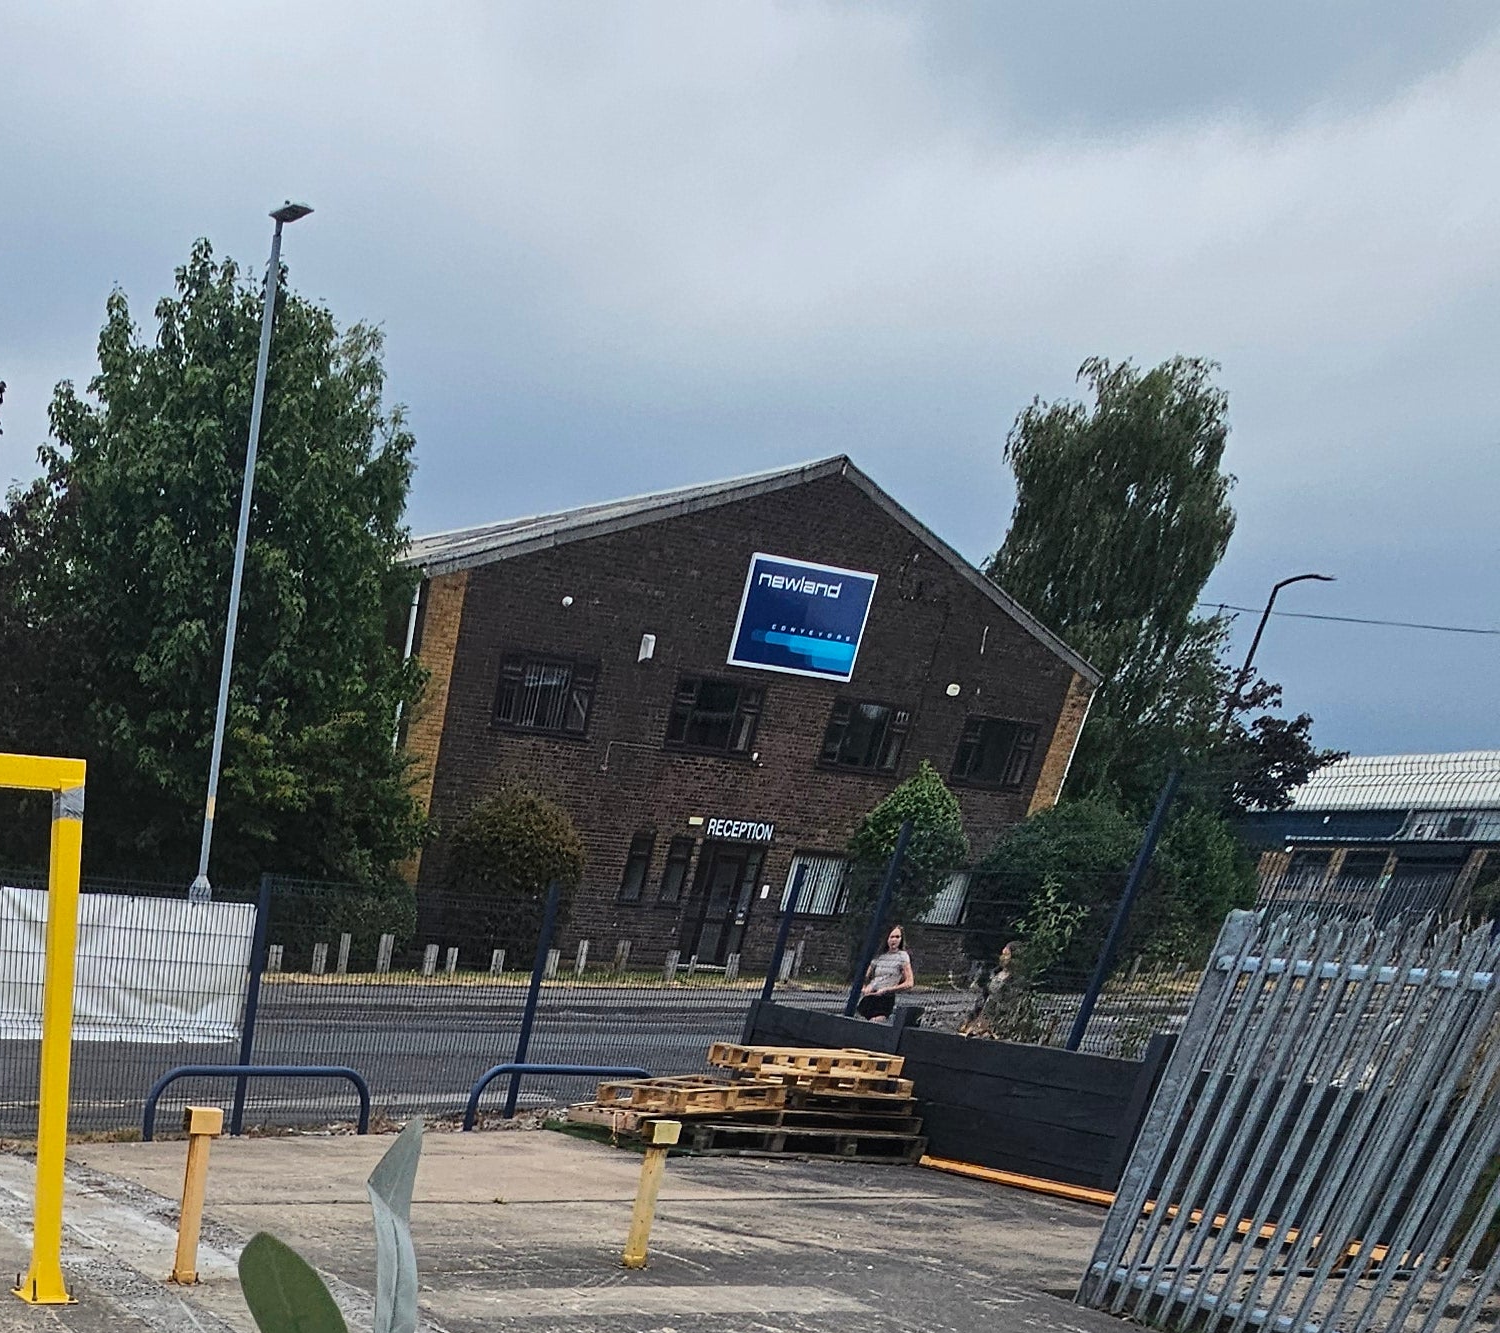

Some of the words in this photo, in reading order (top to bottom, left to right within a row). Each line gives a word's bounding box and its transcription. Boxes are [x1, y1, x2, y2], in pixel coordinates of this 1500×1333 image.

[759, 573, 842, 598] newland
[771, 624, 851, 642] CONVEYORS
[707, 818, 774, 841] RECEPTION
